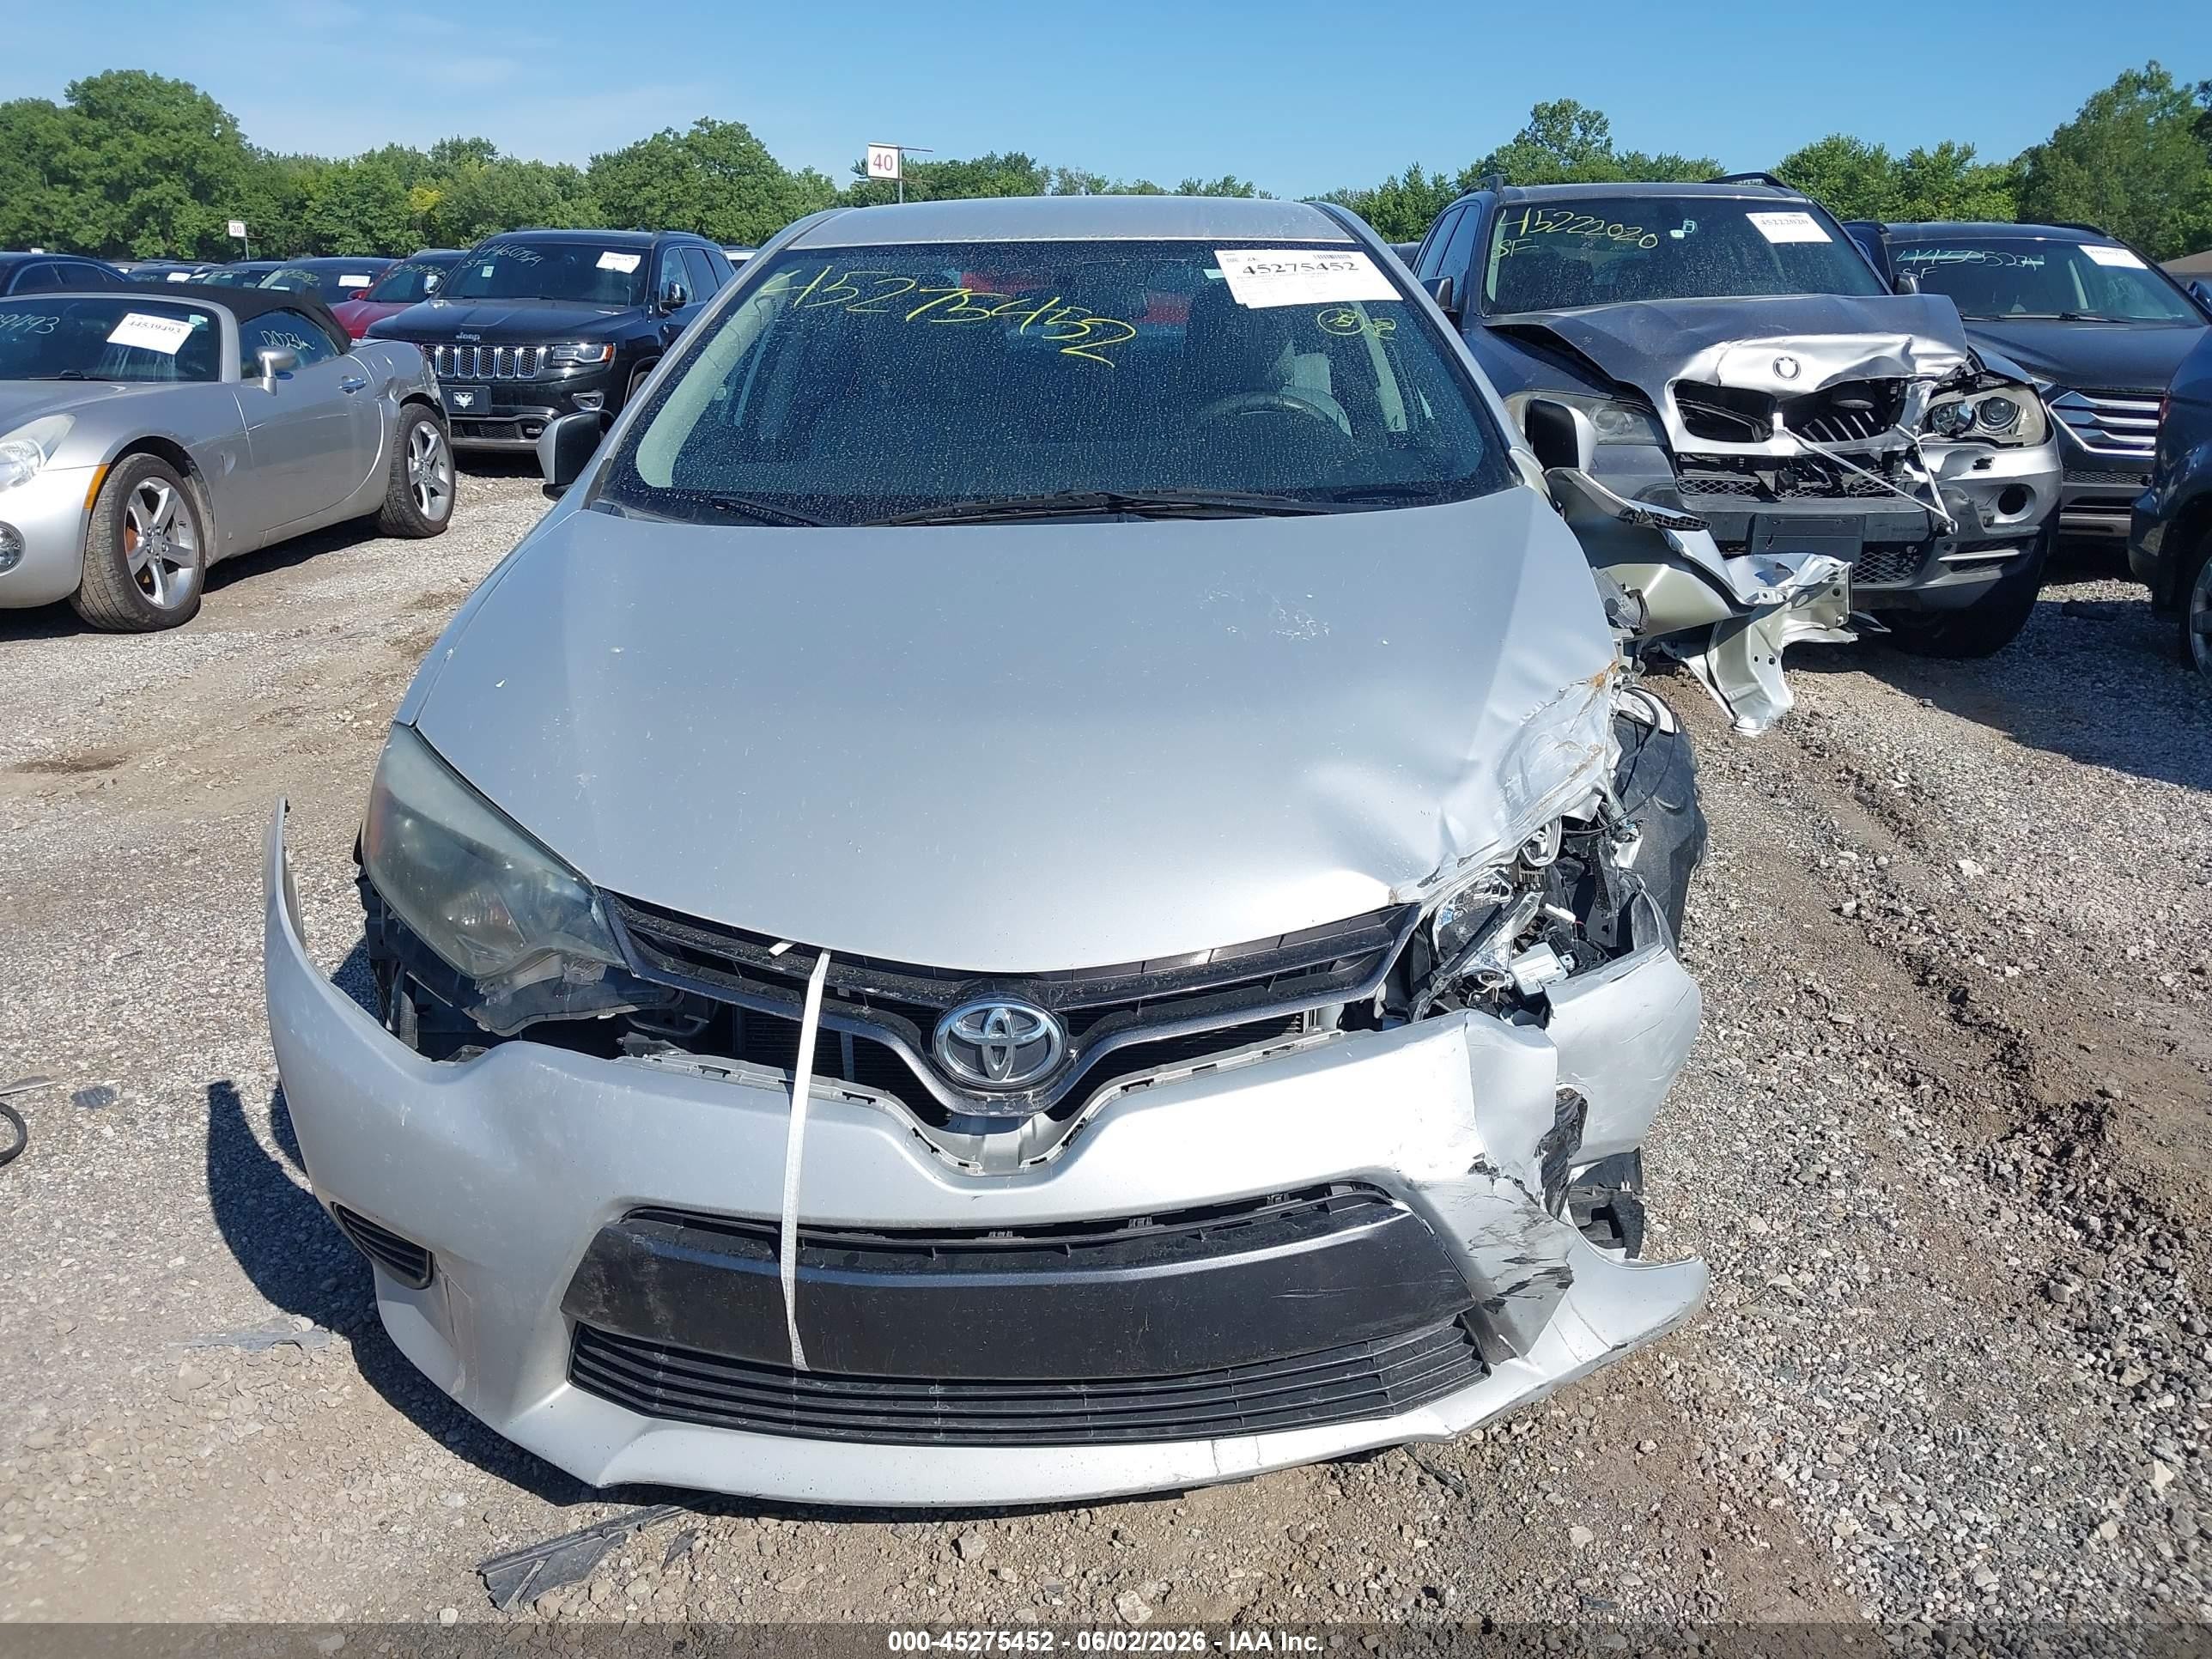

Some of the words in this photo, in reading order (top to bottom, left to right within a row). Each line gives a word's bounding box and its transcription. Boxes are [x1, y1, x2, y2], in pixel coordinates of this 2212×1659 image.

[873, 154, 893, 171] 40
[1498, 208, 1658, 249] 45222020
[1494, 239, 1539, 258] SF
[462, 259, 489, 269] SF
[1243, 262, 1359, 275] 45275452
[761, 265, 1137, 368] 45275452
